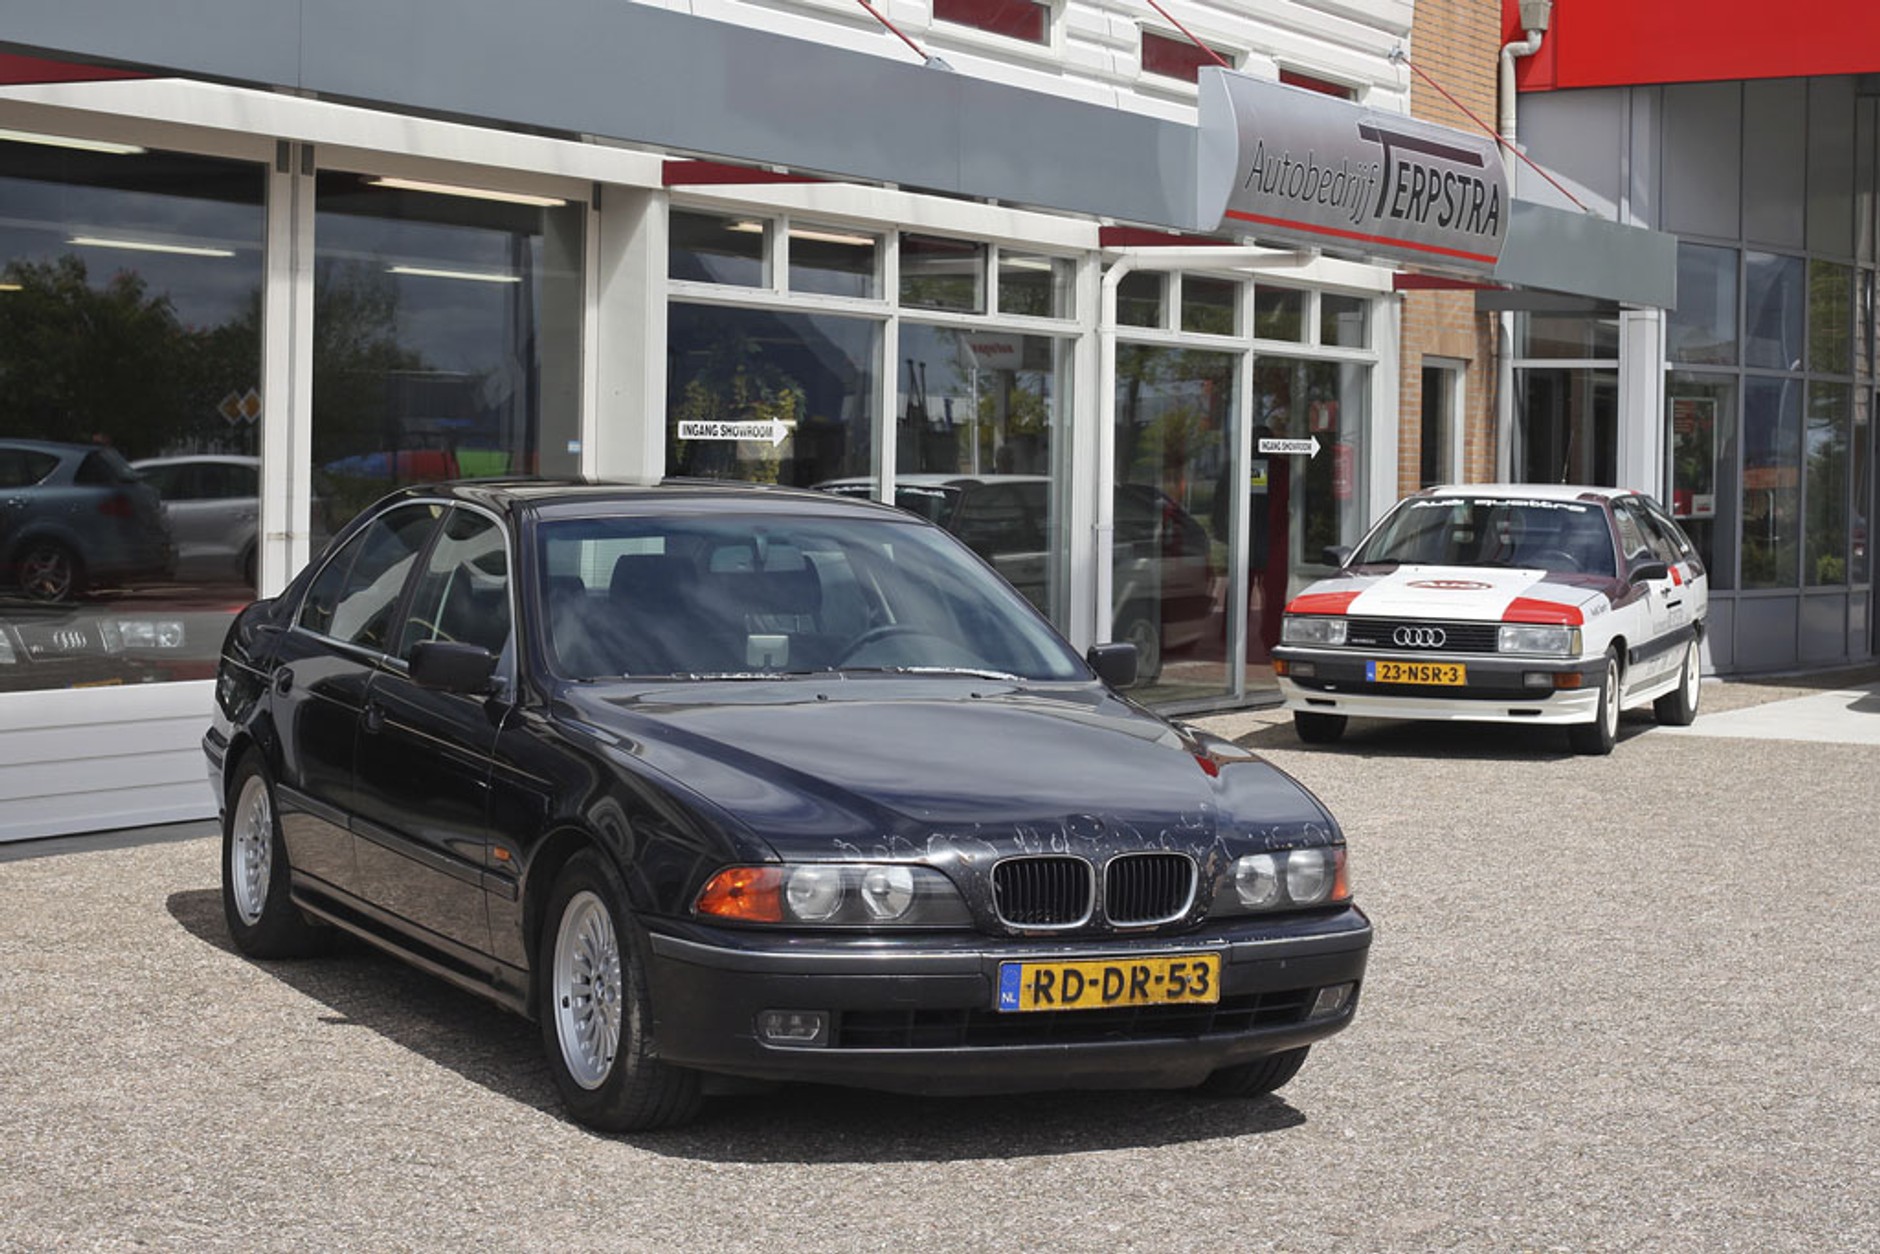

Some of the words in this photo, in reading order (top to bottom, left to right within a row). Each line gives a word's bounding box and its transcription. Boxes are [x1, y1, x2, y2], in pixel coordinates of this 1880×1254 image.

[1245, 139, 1378, 224] Autobedrijf
[1358, 123, 1500, 236] TERPSTRA
[682, 424, 718, 437] INGANG
[720, 424, 773, 438] SHOWROOM
[1382, 664, 1459, 683] 23-NSR-3
[1033, 962, 1210, 1004] RD-DR-53
[1002, 992, 1017, 1003] NL
